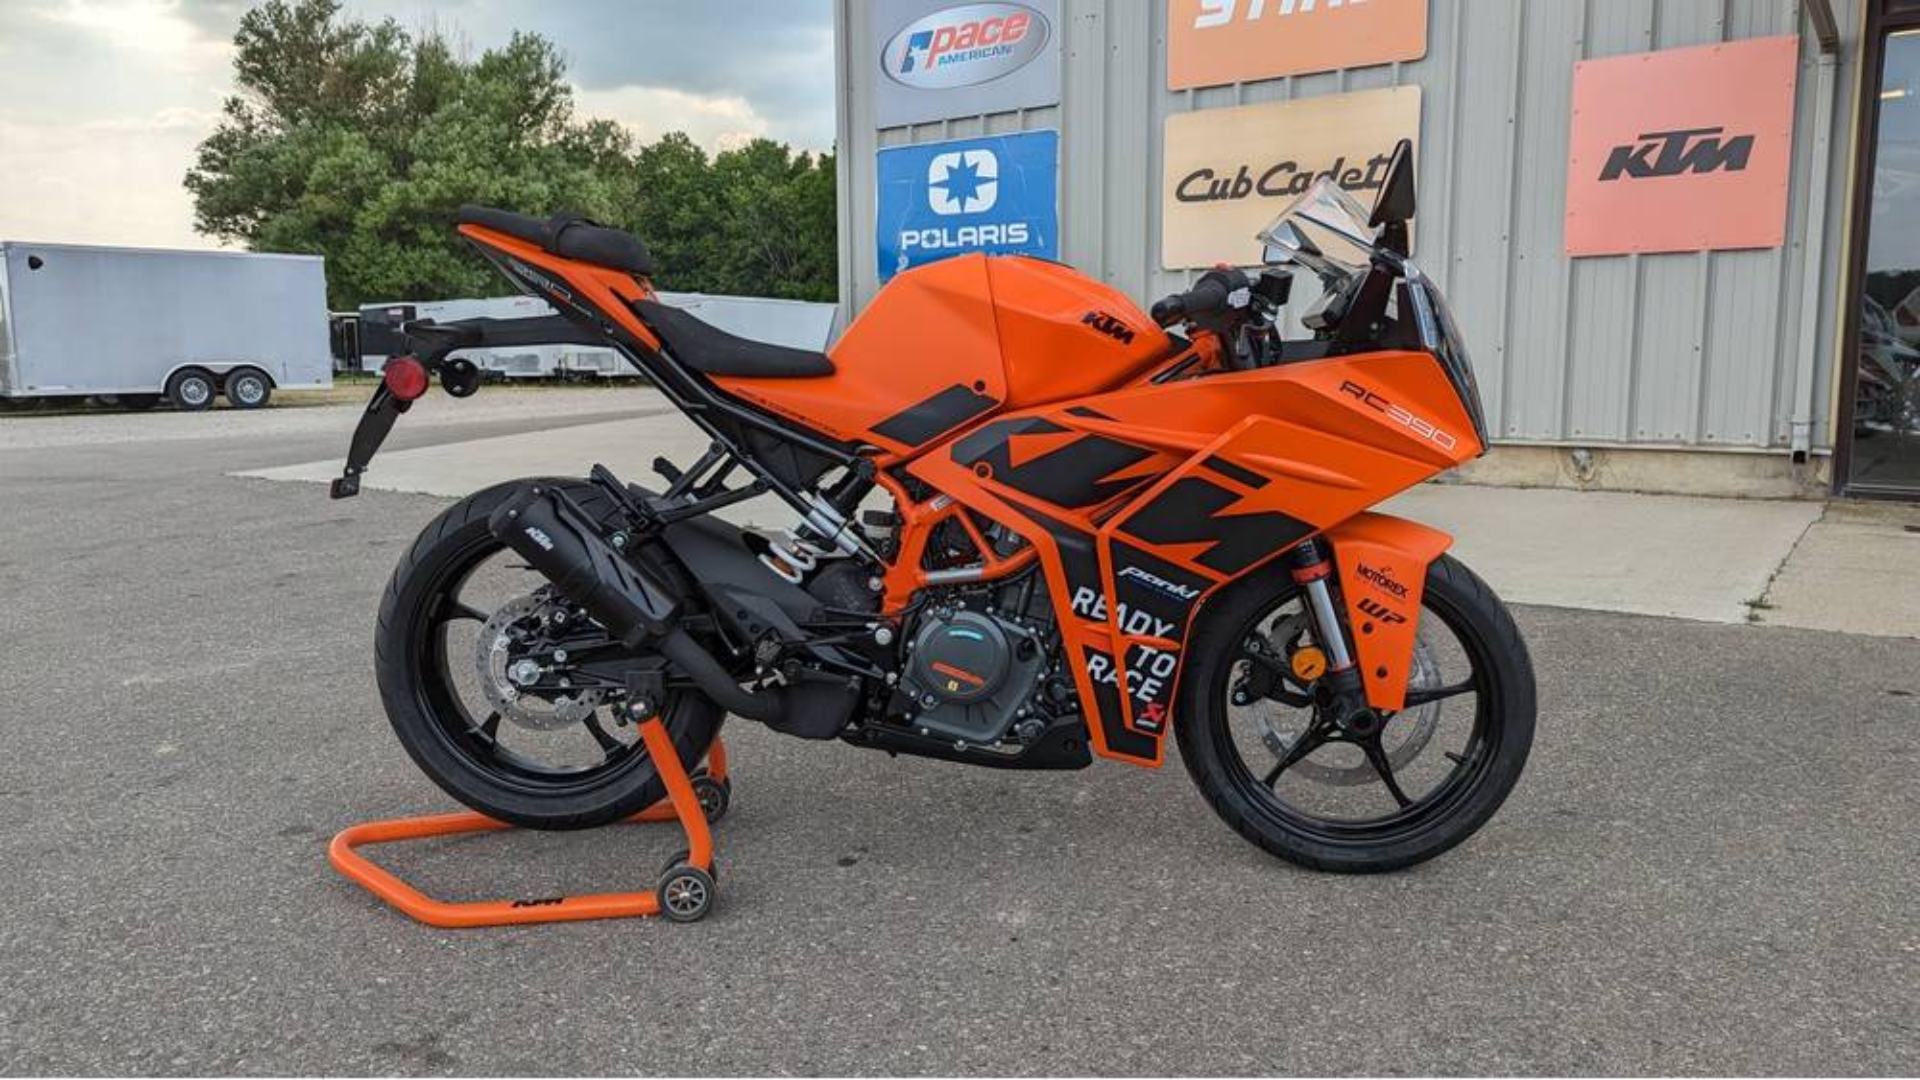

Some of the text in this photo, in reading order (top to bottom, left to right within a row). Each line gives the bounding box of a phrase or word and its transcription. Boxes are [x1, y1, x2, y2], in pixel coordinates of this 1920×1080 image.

[938, 45, 1014, 66] AMERICAN
[1598, 126, 1756, 181] KTM
[1175, 165, 1253, 202] Cub
[901, 222, 1030, 250] POLARIS
[1081, 311, 1136, 346] KTM
[525, 526, 554, 551] KTM
[1356, 563, 1409, 599] MOTOREX
[1071, 586, 1175, 638] READY
[1356, 598, 1407, 625] WP
[1086, 653, 1164, 703] RACE
[1134, 644, 1177, 679] TO
